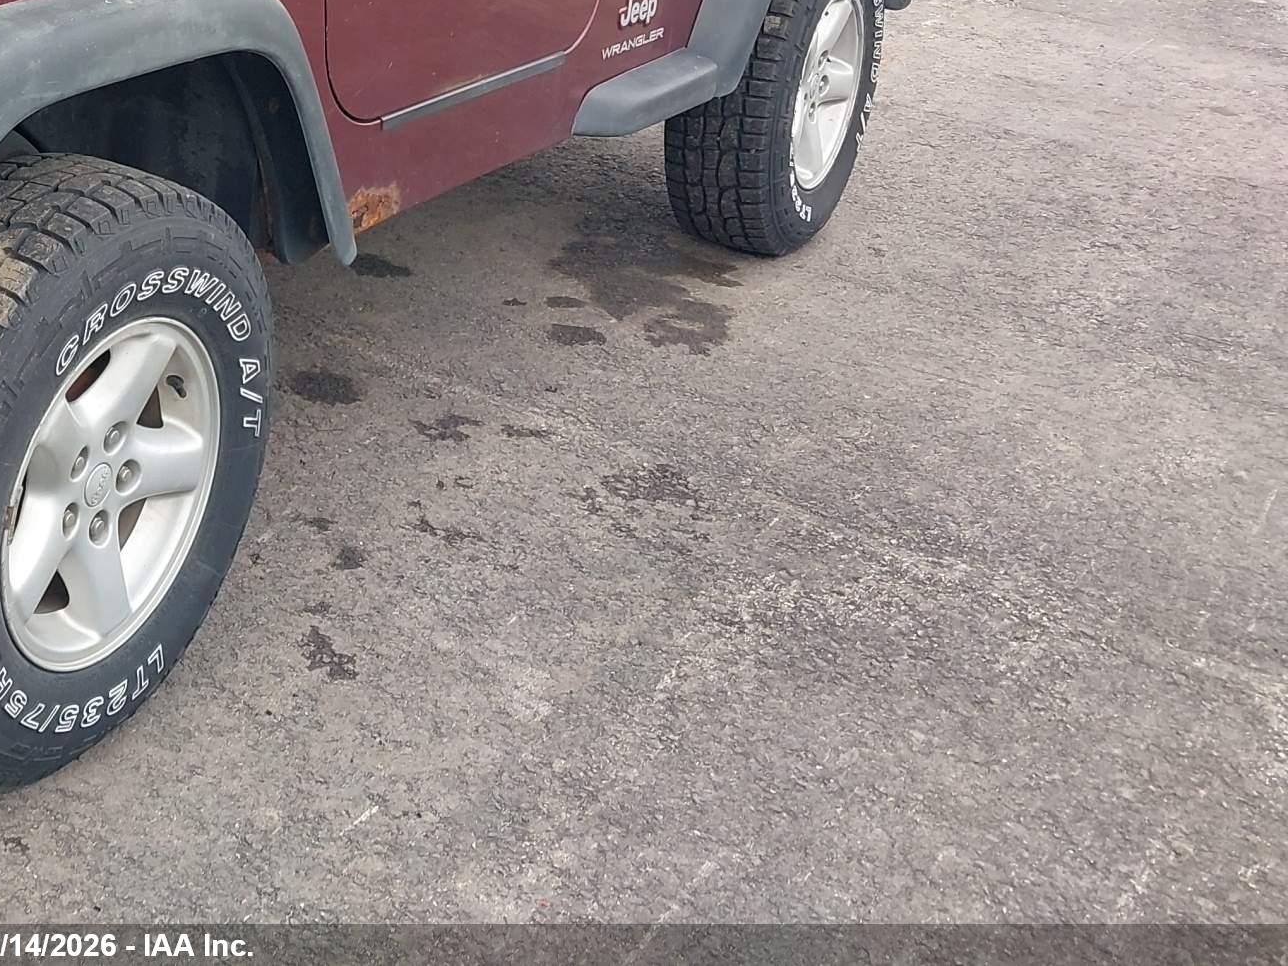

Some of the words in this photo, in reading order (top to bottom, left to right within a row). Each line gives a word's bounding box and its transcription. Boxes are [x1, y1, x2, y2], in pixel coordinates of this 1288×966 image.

[601, 27, 665, 61] WRANGLER
[56, 267, 252, 376] CROSSWIND
[239, 358, 263, 437] A/T
